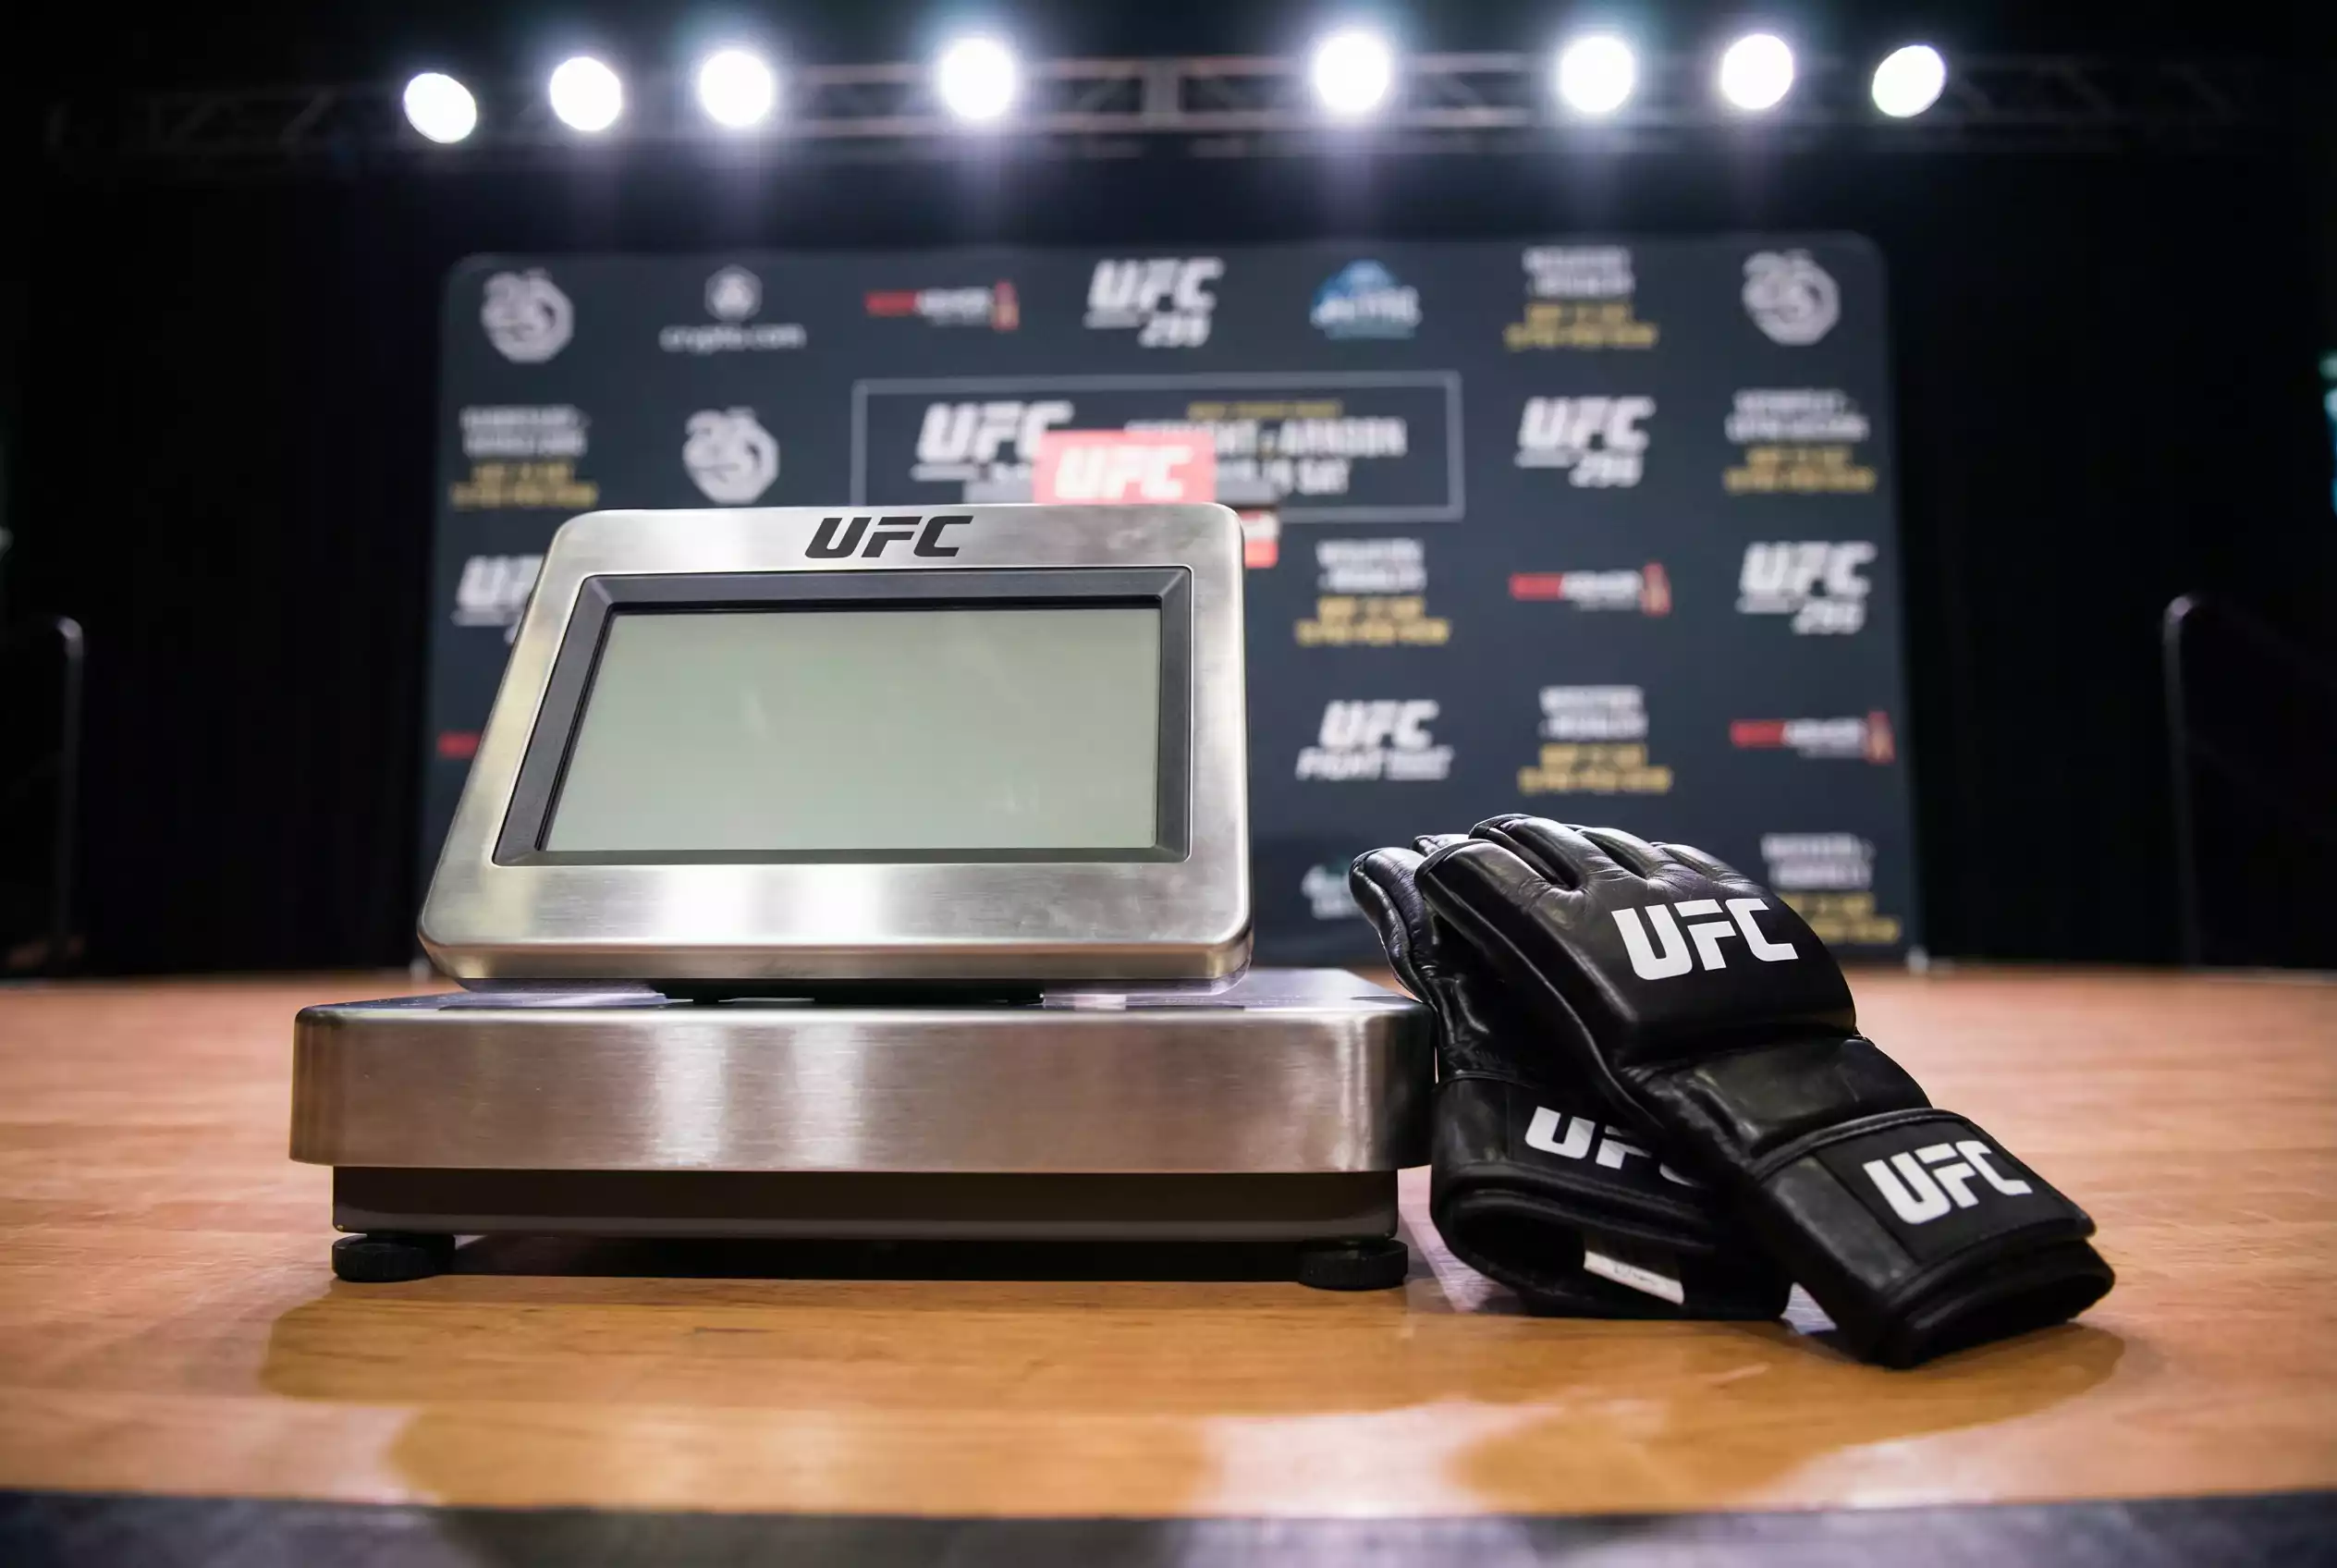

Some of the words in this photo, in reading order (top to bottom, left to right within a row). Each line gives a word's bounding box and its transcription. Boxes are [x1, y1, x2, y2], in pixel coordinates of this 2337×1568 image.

[1088, 257, 1225, 309] UFC
[1518, 396, 1656, 448] UFC
[1055, 445, 1192, 499] UFC
[805, 516, 973, 558] UFC
[457, 555, 547, 608] UF
[1740, 542, 1878, 594] UFC
[1319, 700, 1438, 749] UFC
[1611, 897, 1799, 980] UFC
[1525, 1106, 1694, 1187] UF
[1862, 1140, 2033, 1224] UFC
